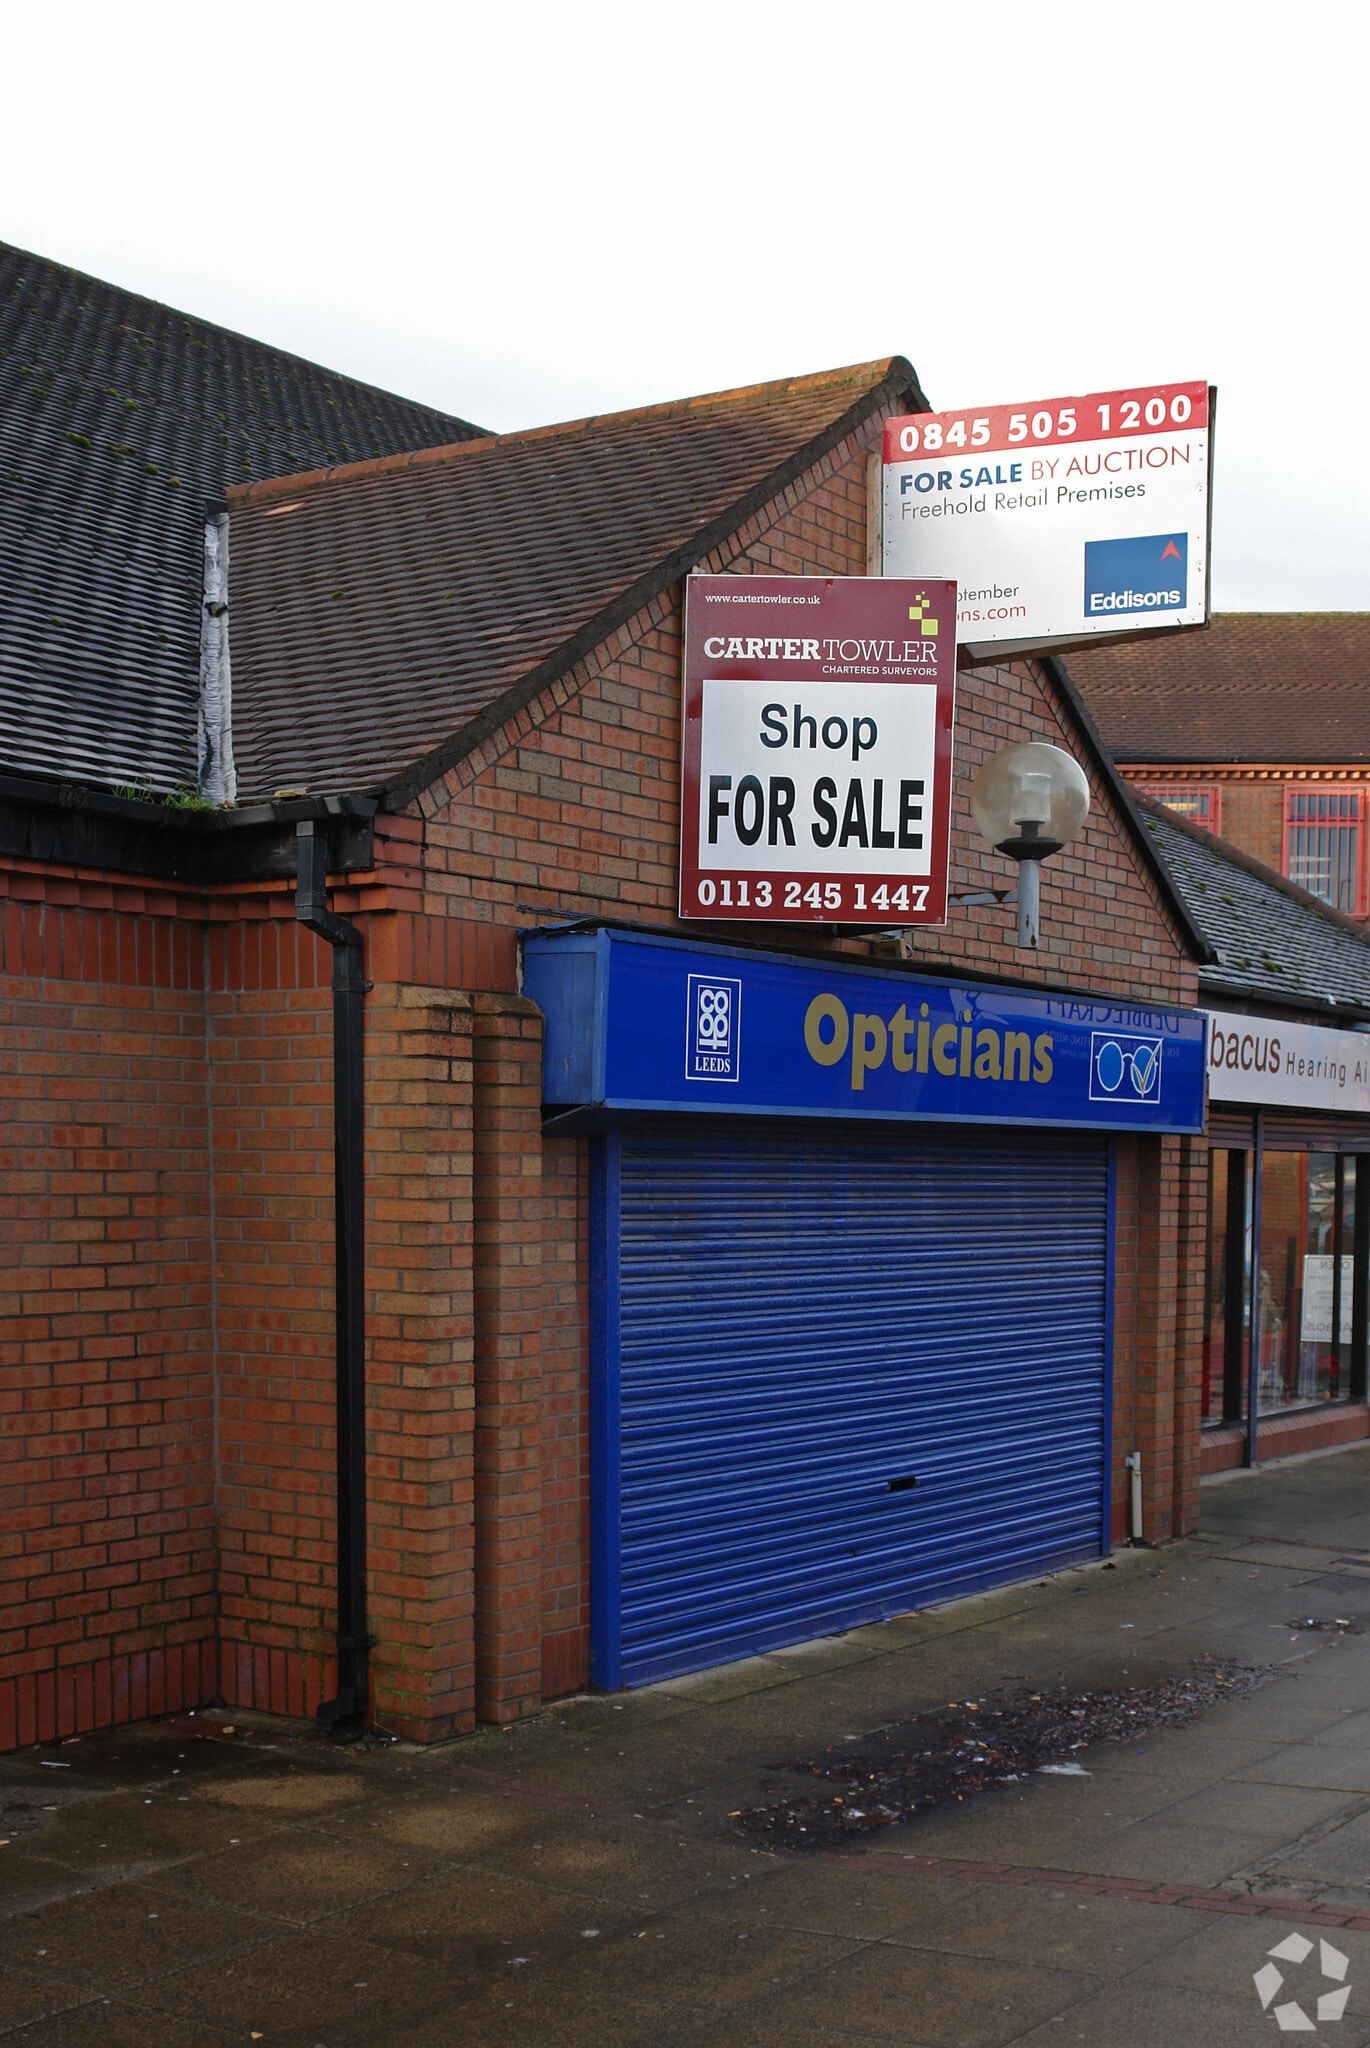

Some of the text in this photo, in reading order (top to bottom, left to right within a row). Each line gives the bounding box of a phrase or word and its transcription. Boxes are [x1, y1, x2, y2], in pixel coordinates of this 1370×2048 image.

[899, 394, 1192, 453] 0845 505 1200
[900, 443, 1190, 495] FOR SALE BY AUCTION
[901, 481, 1146, 520] Freehold Retail Premises
[705, 594, 820, 605] www.cartertowler.co.uk
[956, 604, 1026, 623] ns.com
[1090, 589, 1181, 611] Eddisons
[822, 665, 938, 676] CHARTERED SURVEYORS
[759, 703, 878, 761] Shop
[708, 774, 925, 850] FOR SALE
[698, 879, 930, 911] 0113 245 1447
[804, 992, 1054, 1091] Opticians
[1209, 1018, 1281, 1074] bacus
[1286, 1051, 1347, 1088] Hearing
[695, 1056, 731, 1073] LEEDS
